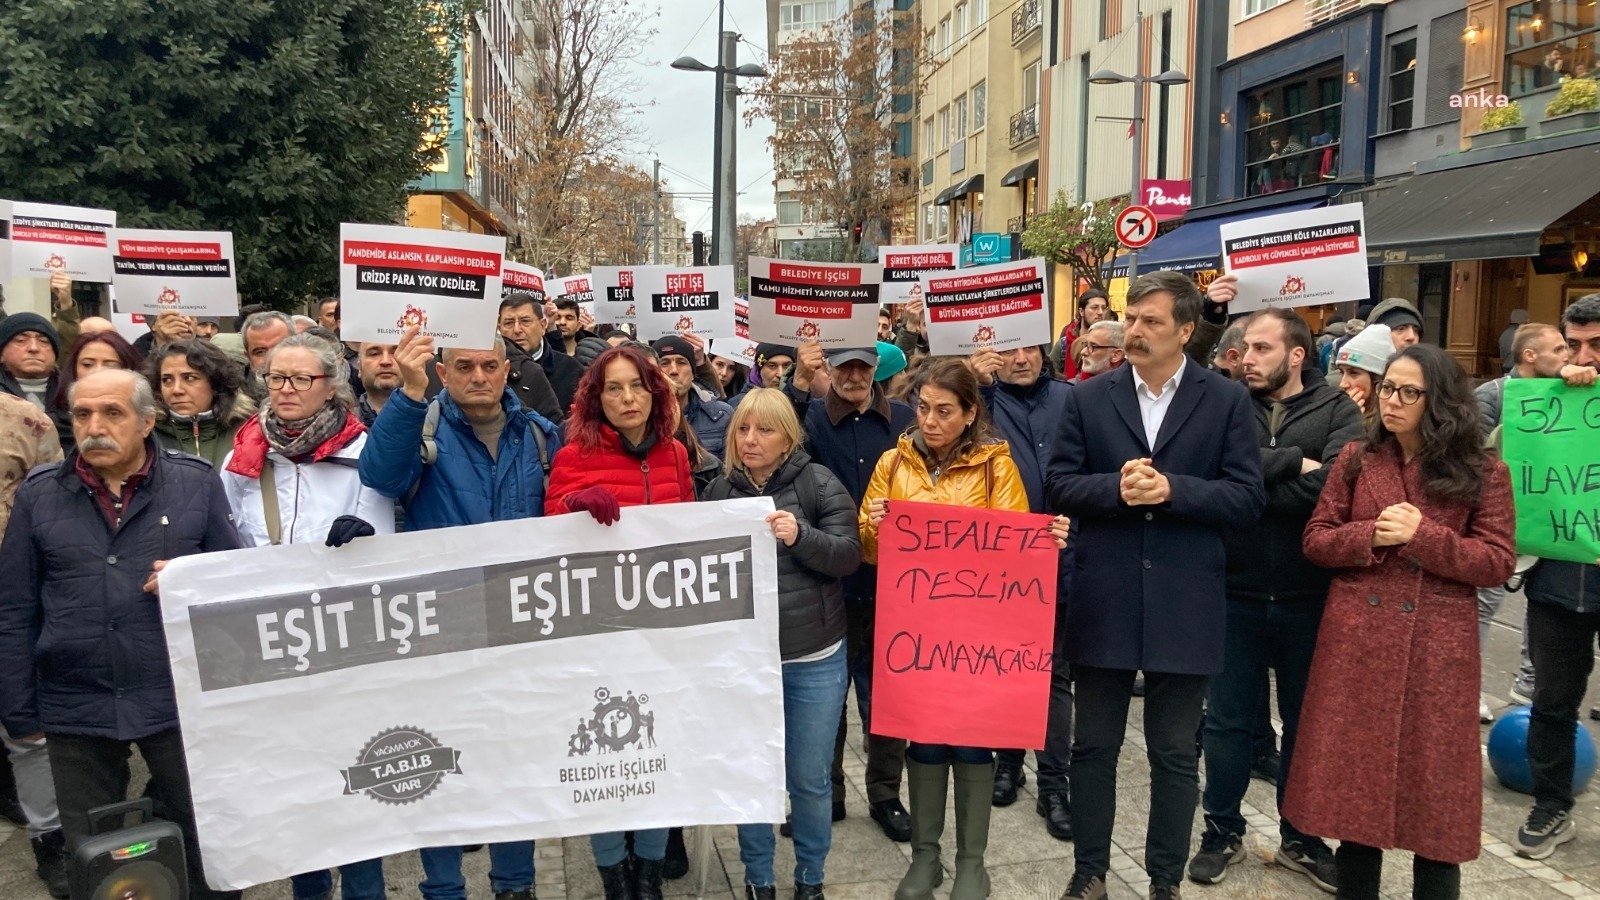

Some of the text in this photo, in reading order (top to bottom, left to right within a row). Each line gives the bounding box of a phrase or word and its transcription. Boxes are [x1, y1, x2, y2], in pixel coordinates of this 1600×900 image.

[980, 241, 994, 250] W
[1232, 226, 1355, 250] BELEDİYE ŞİRKETLERİ KÖLE PAZARLARIDIR
[166, 246, 217, 255] ÇALIŞANLARINA,
[348, 248, 496, 270] PANDEMİDE ASLANSIN, KAPLANSIN DEDİLER;
[1234, 254, 1262, 265] KADROLU
[1270, 247, 1300, 260] GÜVENCELİ
[1300, 246, 1325, 258] ÇALIŞMA
[1326, 240, 1356, 252] İSTİYORUZ
[890, 254, 948, 267] ŞİRKET İŞÇİSİ DEĞİL,
[361, 269, 480, 292] KRİZDE PARA YOK DEDİLER..
[504, 272, 513, 281] KET
[514, 272, 528, 285] İŞÇİSİ
[668, 274, 702, 292] EŞİT İŞE
[781, 267, 850, 283] BELEDİYE İŞÇİSİ
[932, 281, 953, 289] YEDİNİZ
[954, 277, 983, 288] BİTİRDİNİZ,
[984, 272, 1024, 283] BANKALARDAN
[566, 280, 588, 292] EŞİT İŞE
[614, 286, 630, 300] EŞİT
[758, 284, 780, 293] KAMU
[782, 285, 813, 296] HİZMETİ
[814, 289, 849, 297] YAPIYOR
[955, 292, 982, 300] KATLAYAN
[983, 286, 1020, 300] ŞİRKETLERDEN
[661, 293, 710, 311] EŞİT ÜCRET
[781, 304, 818, 313] KADROSU
[939, 308, 960, 319] BÜTÜN
[962, 305, 999, 318] EMEKÇİLERE
[1516, 396, 1576, 434] 52
[1522, 460, 1600, 495] İLAVE
[895, 514, 1052, 553] SEFALETE
[896, 568, 1050, 604] TESLİM
[256, 552, 745, 672] EŞİT İŞE EŞİT ÜCRET
[374, 738, 422, 757] YAĞMA YOK
[370, 754, 432, 779] T.A.B.İ.B
[559, 754, 667, 783] BELEDİYE İŞÇİLERİ
[392, 778, 421, 794] VAR!
[573, 780, 656, 804] DAYANIŞMASI
